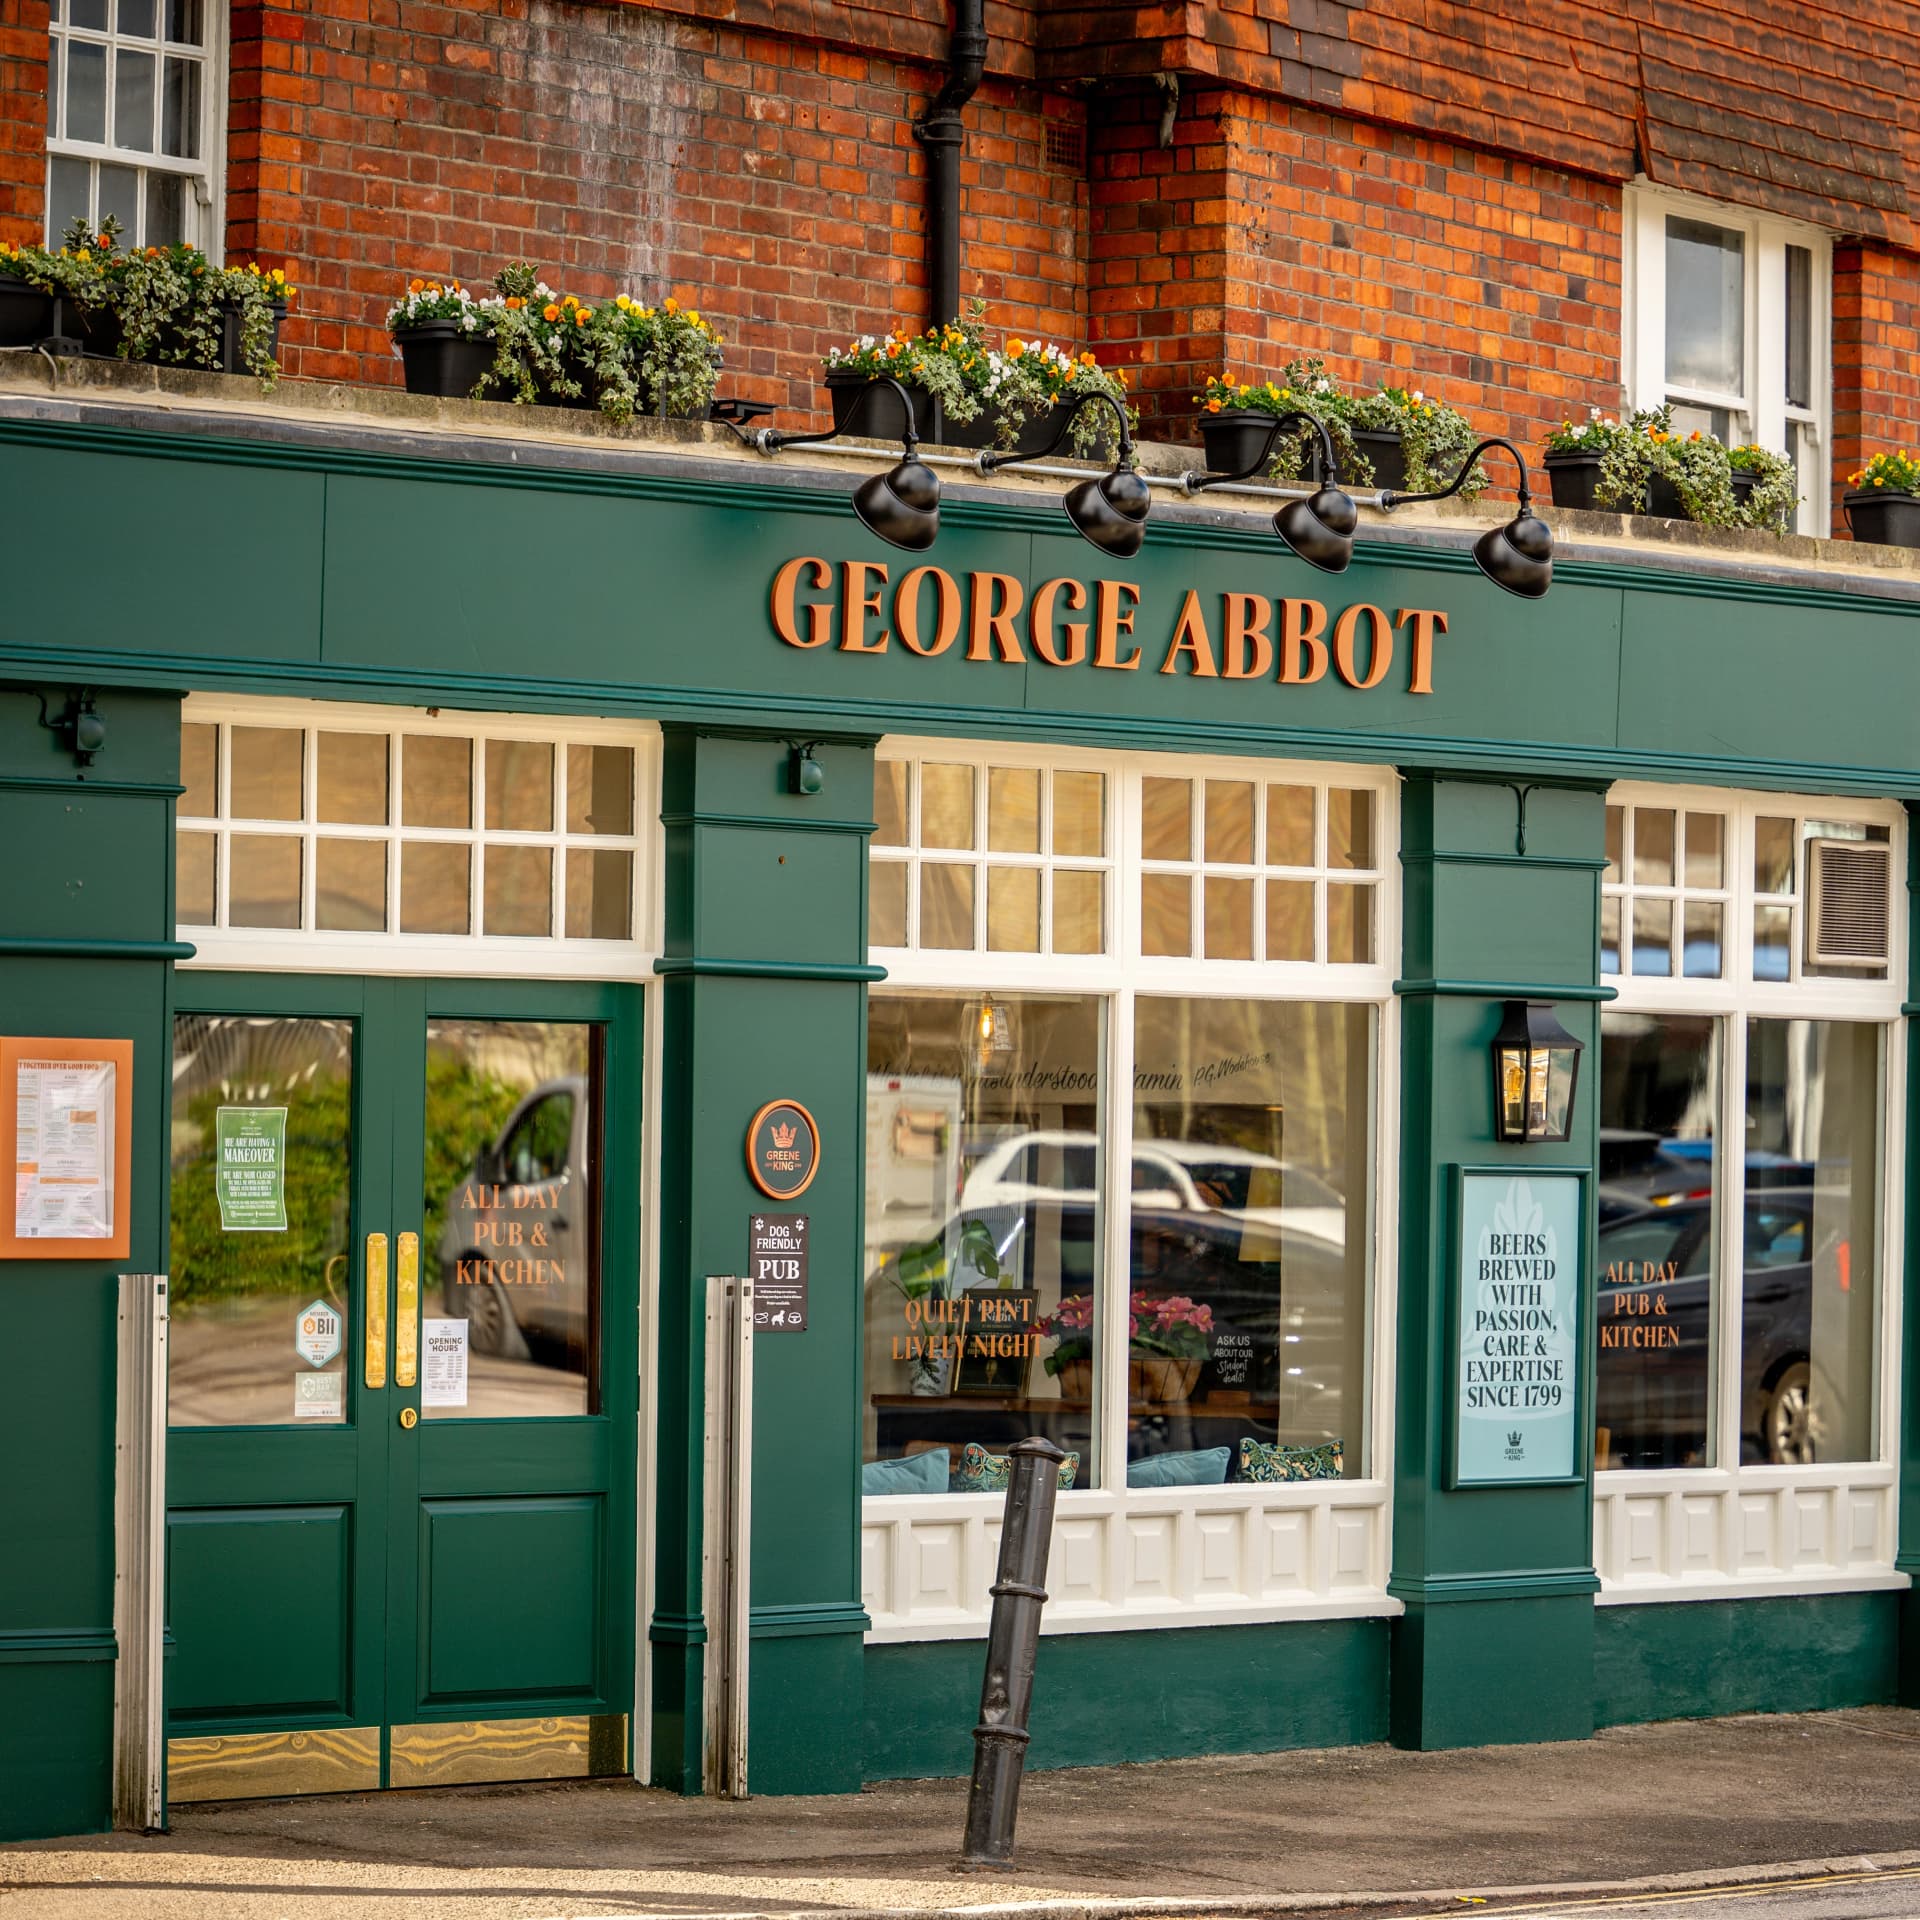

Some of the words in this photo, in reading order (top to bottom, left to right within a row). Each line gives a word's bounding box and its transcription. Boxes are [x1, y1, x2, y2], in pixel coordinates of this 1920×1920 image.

[769, 556, 1141, 671] GEORGE
[1159, 588, 1448, 694] ABBOT
[249, 1137, 270, 1147] HAVING
[271, 1137, 276, 1147] A
[224, 1148, 275, 1163] MAKEOVER
[766, 1150, 800, 1160] GREENE
[773, 1161, 794, 1171] KING
[256, 1170, 276, 1180] CLOSED
[460, 1184, 506, 1209] ALL
[513, 1184, 563, 1209] DAY
[474, 1222, 523, 1247] PUB
[530, 1222, 548, 1247] &
[769, 1225, 790, 1237] DOG
[757, 1238, 802, 1250] FRIENDLY
[1489, 1234, 1546, 1256] BEERS
[456, 1259, 565, 1285] KITCHEN
[758, 1259, 800, 1280] PUB
[1478, 1259, 1556, 1281] BREWED
[1605, 1261, 1638, 1283] ALL
[1642, 1261, 1678, 1283] DAY
[1491, 1284, 1541, 1306] WITH
[1614, 1293, 1650, 1316] PUB
[1654, 1293, 1668, 1315] &
[904, 1298, 974, 1331] QUIET
[980, 1298, 1033, 1322] PINT
[1475, 1310, 1557, 1334] PASSION,
[317, 1318, 335, 1335] BII
[1601, 1325, 1680, 1348] KITCHEN
[428, 1337, 463, 1345] OPENING
[432, 1344, 459, 1352] HOURS
[892, 1334, 968, 1360] LIVELY
[974, 1333, 1043, 1358] NIGHT
[1216, 1335, 1236, 1346] ASK
[1237, 1335, 1250, 1346] US
[1483, 1335, 1530, 1357] CARE
[1533, 1334, 1547, 1356] &
[1213, 1348, 1239, 1358] ABOUT
[1239, 1348, 1254, 1358] OUR
[1216, 1358, 1248, 1374] Student
[1467, 1359, 1563, 1383] EXPERTISE
[1467, 1385, 1519, 1408] SINCE
[1524, 1385, 1562, 1407] 1799
